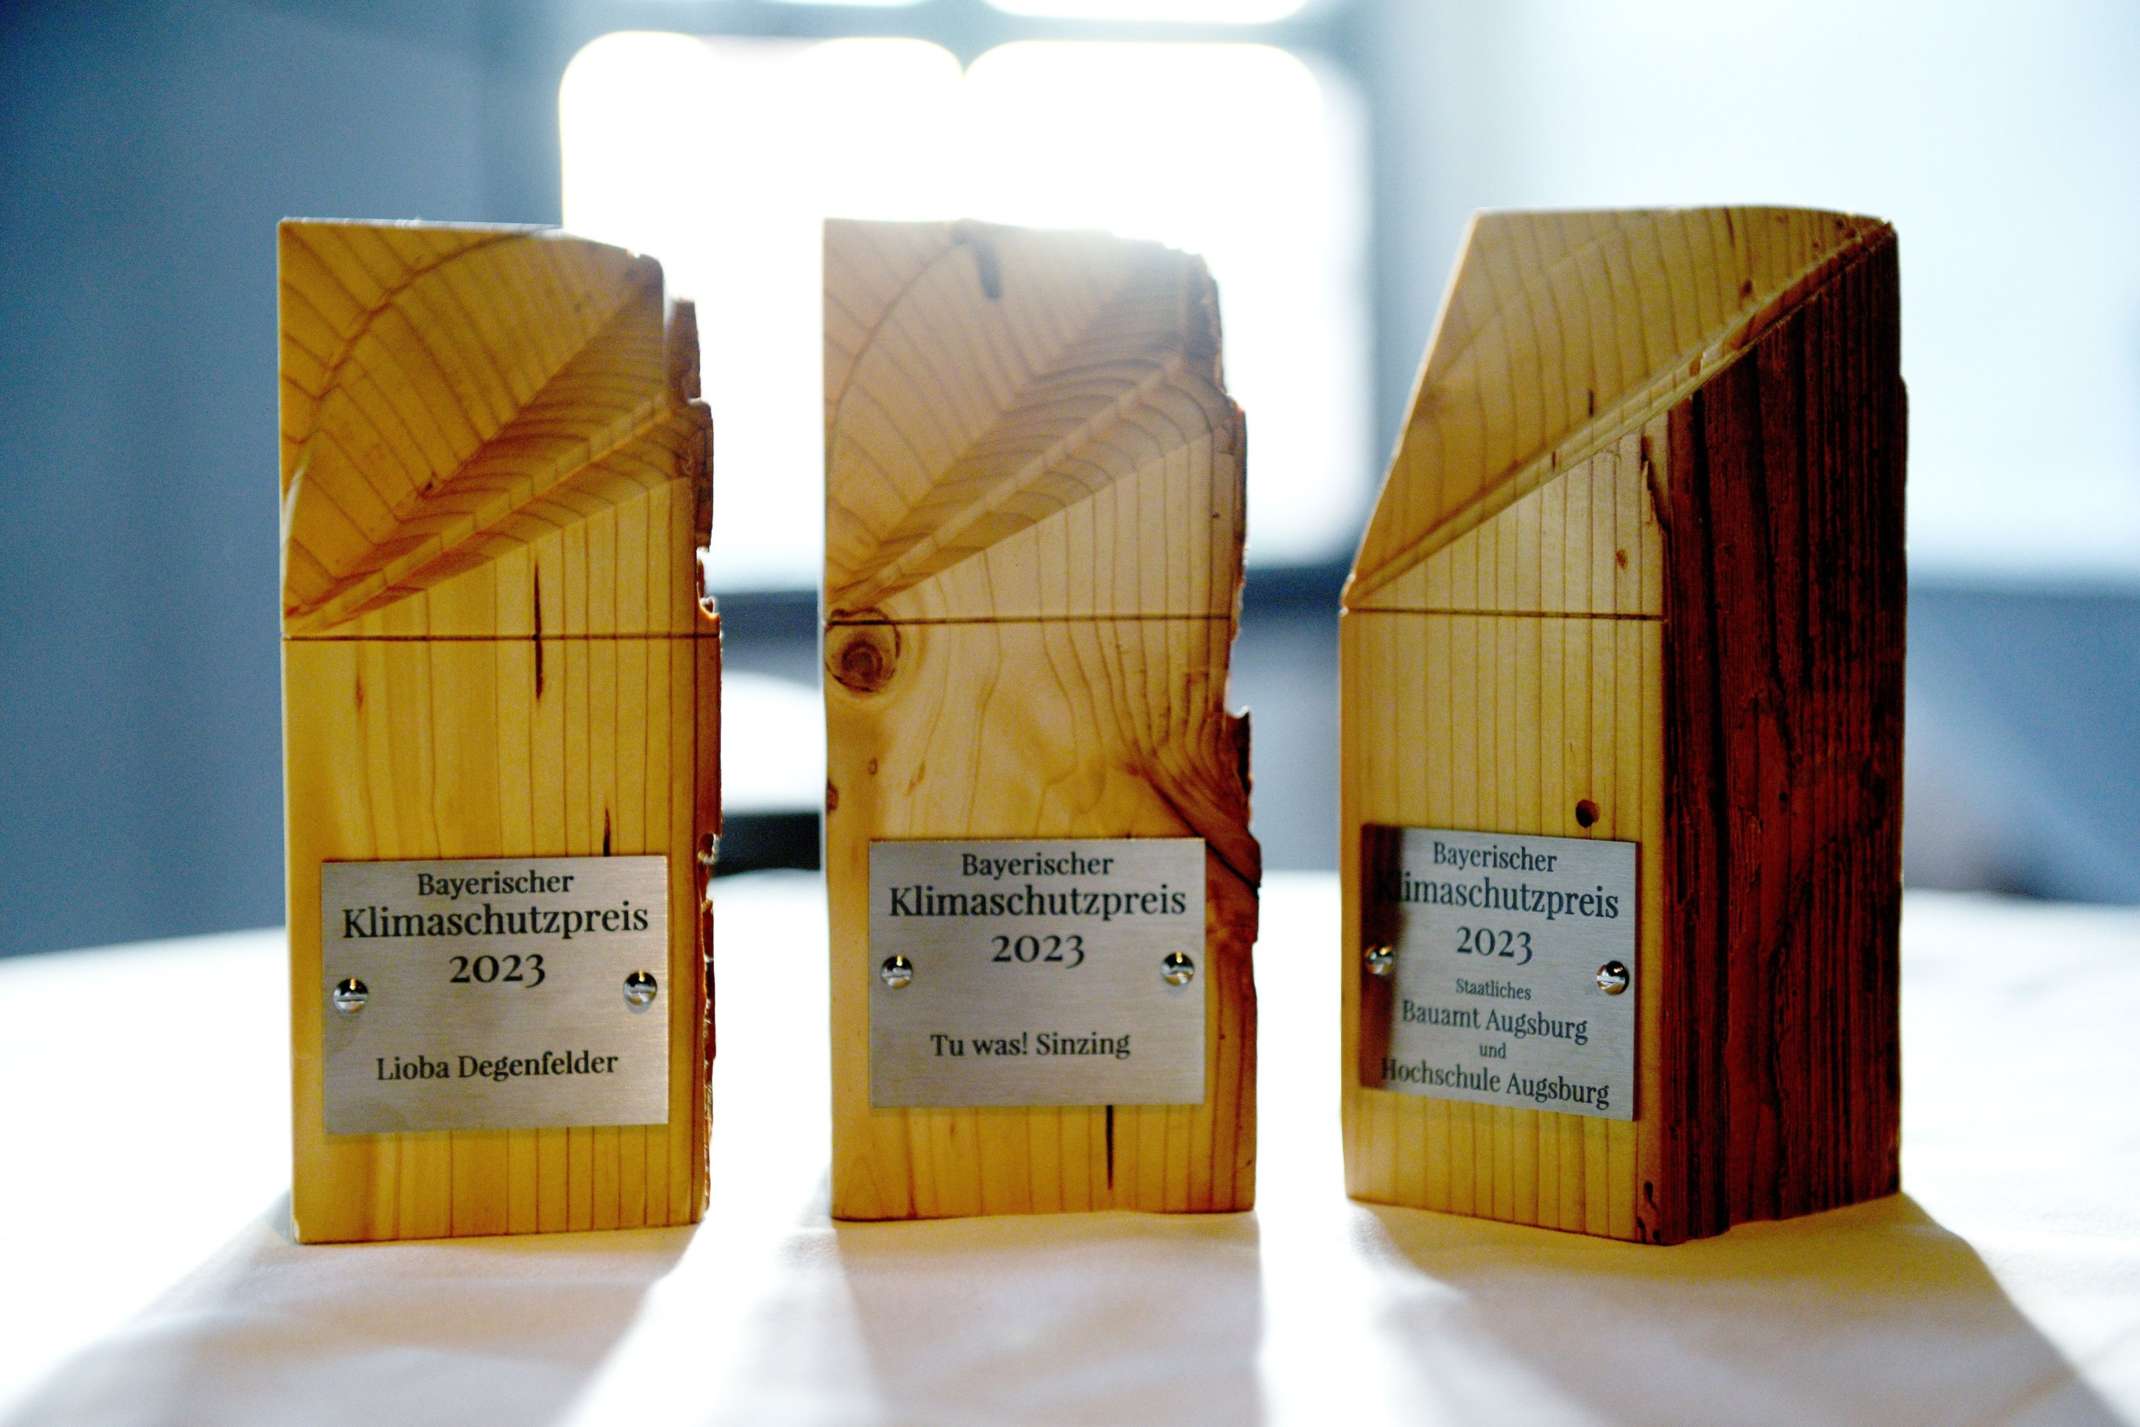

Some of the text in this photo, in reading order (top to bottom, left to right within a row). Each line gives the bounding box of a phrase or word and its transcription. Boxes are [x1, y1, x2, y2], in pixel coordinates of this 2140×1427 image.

[961, 851, 1114, 881] Bayerischer
[1433, 841, 1558, 872] Bayerischer
[417, 870, 574, 900] Bayerischer
[1377, 871, 1620, 920] imaschutzpreis
[889, 884, 1186, 921] Klimaschutzpreis
[342, 901, 649, 939] Klimaschutzpreis
[992, 935, 1085, 969] 2023
[1456, 926, 1533, 966] 2023
[450, 953, 546, 989] 2023
[1455, 978, 1532, 1001] Staatliches
[1402, 1000, 1589, 1045] Bauamt Augsburg
[930, 1031, 1131, 1060] Tu was! Sinzing
[1479, 1042, 1507, 1060] und
[376, 1050, 620, 1082] Lioba Degenfelder
[1381, 1056, 1611, 1110] Hochschule Augsburg
